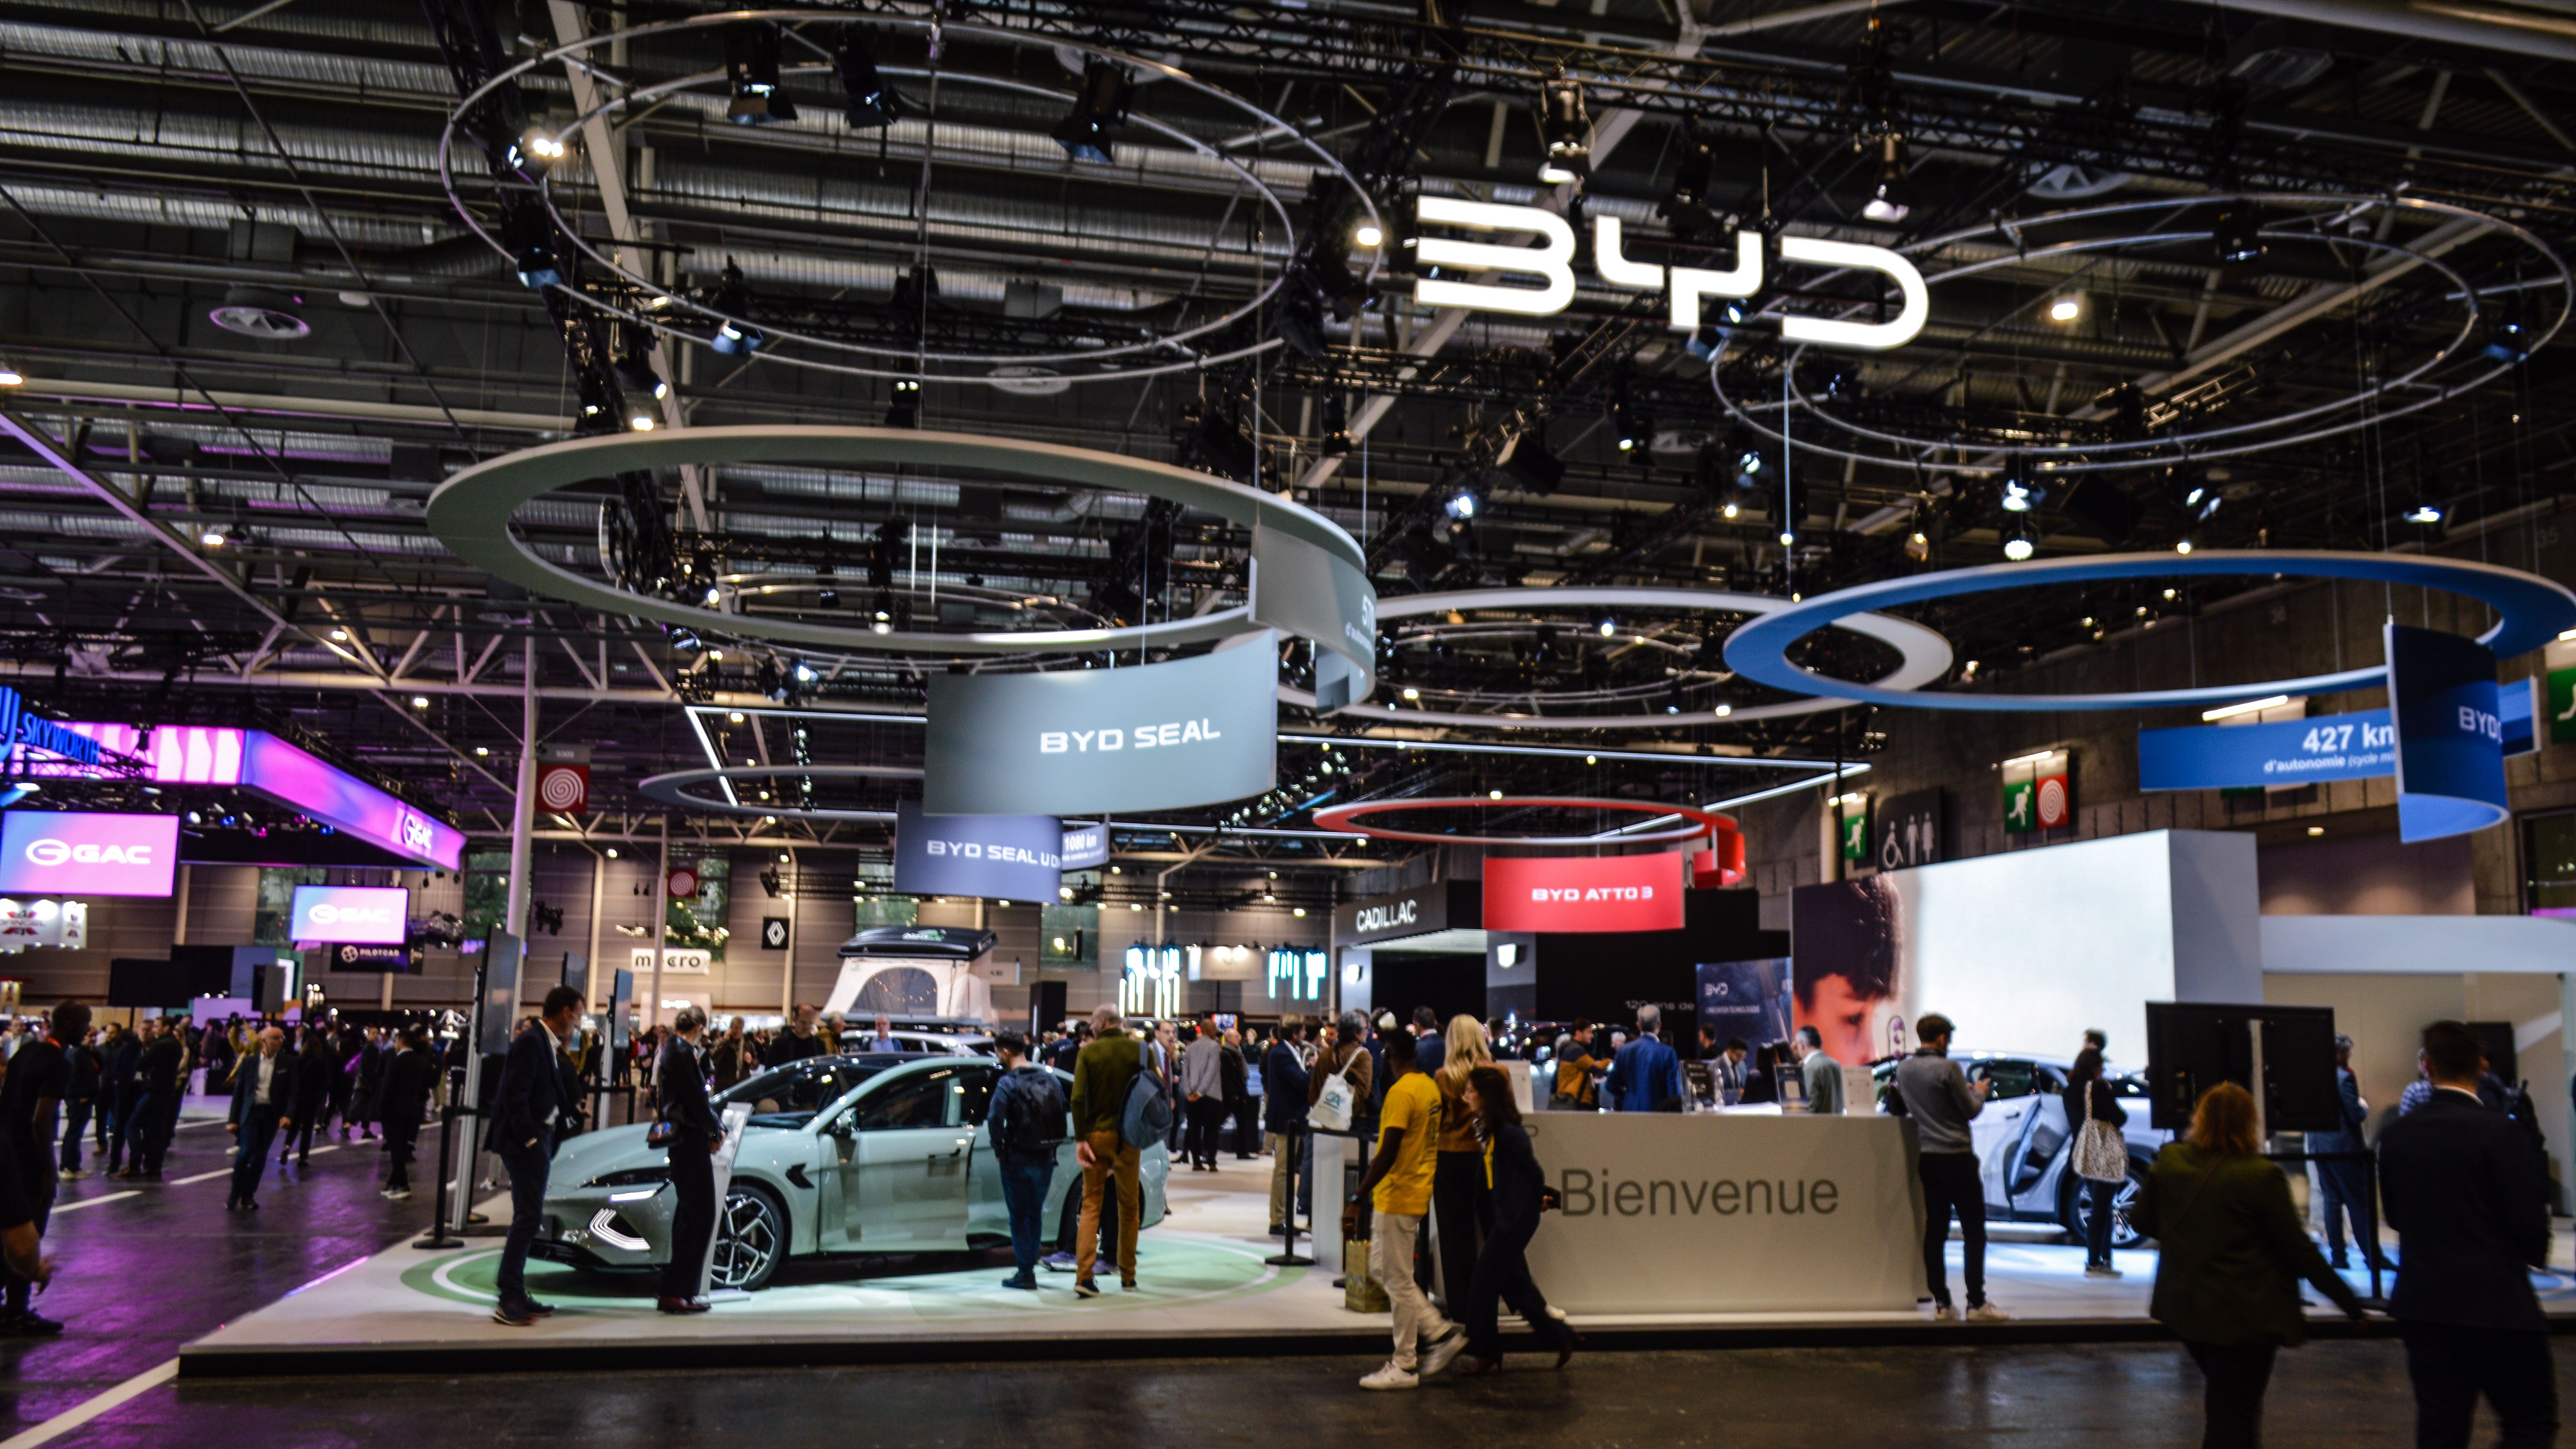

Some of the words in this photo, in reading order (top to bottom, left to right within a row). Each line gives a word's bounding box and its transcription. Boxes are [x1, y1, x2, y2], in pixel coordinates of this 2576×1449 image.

[1417, 195, 1929, 349] BYD
[2458, 706, 2497, 740] BYD
[23, 712, 100, 770] SKYWORTH
[1040, 728, 1124, 753] BYD
[1134, 717, 1221, 748] SEAL
[2302, 724, 2354, 752] 427
[2263, 754, 2346, 773] d'autonomie
[927, 839, 981, 858] BYD
[987, 844, 1038, 864] SEAL
[1064, 833, 1085, 851] 1080
[72, 844, 152, 864] GAC
[1532, 888, 1580, 901] BYD
[1585, 886, 1638, 900] ATTO
[1641, 885, 1653, 899] 3
[1356, 899, 1417, 933] CADILLAC
[359, 948, 400, 957] PILOTCAR
[635, 955, 701, 968] mcro
[1704, 982, 1728, 996] BYD
[1679, 1002, 1695, 1010] de
[1561, 1168, 1839, 1216] Bienvenue
